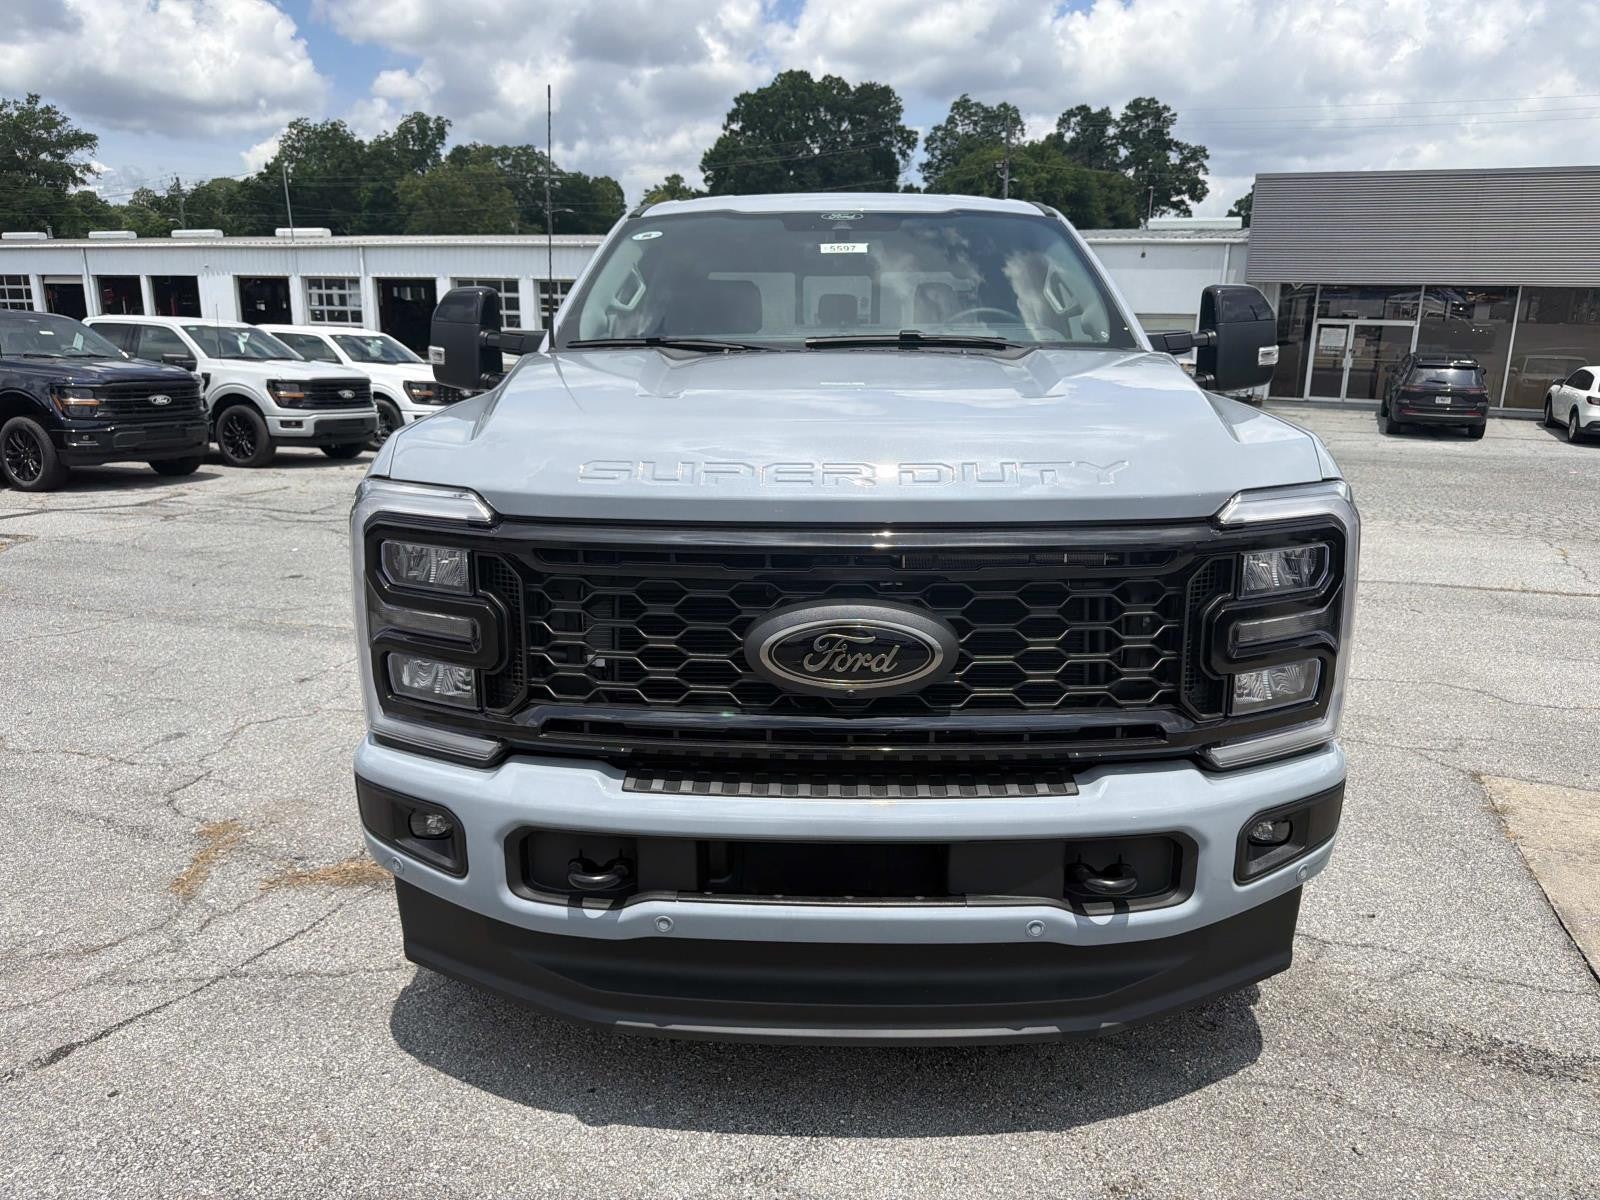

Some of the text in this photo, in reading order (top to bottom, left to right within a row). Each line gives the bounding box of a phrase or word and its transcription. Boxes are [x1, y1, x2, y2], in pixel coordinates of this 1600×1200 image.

[829, 244, 857, 252] 5597
[578, 459, 1130, 487] SUPER DUTY
[803, 633, 900, 673] Ford
